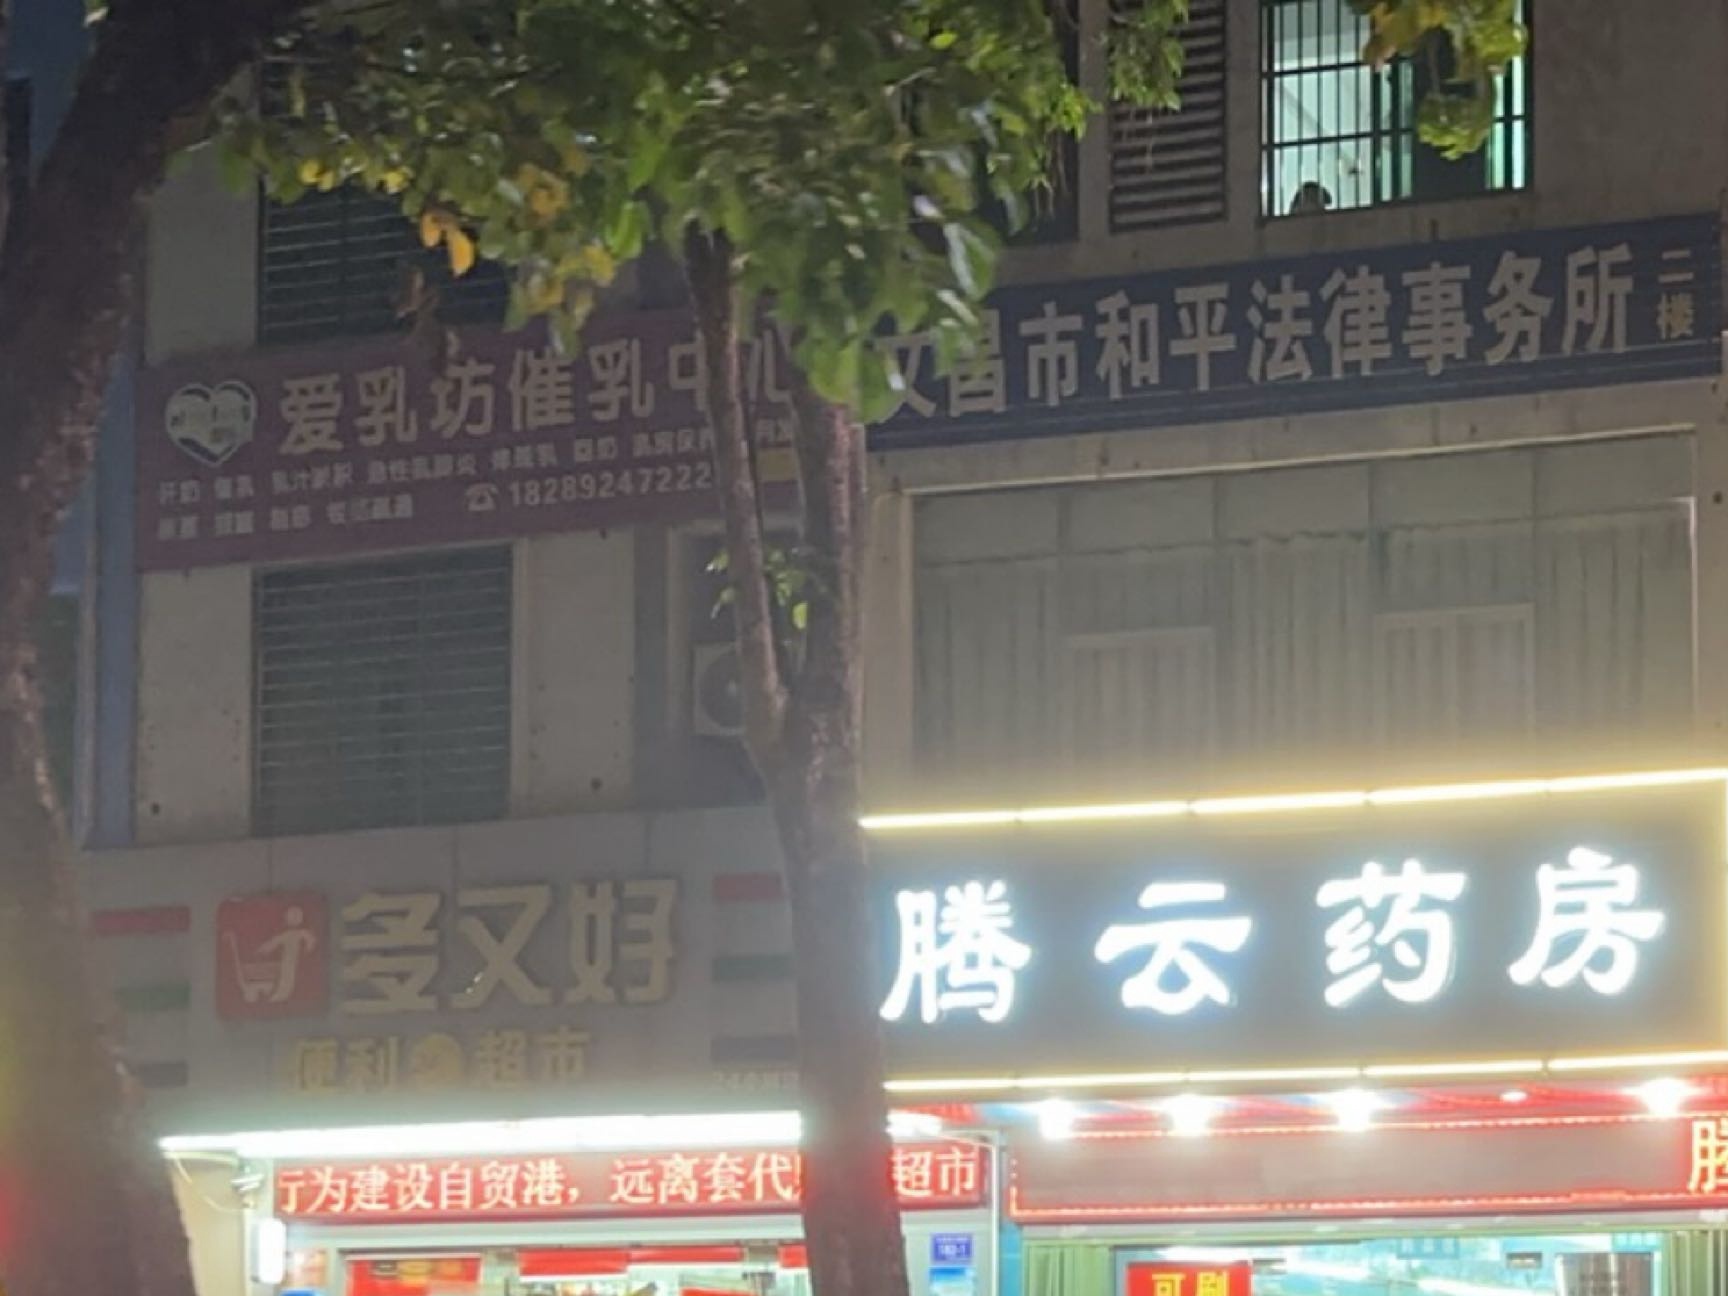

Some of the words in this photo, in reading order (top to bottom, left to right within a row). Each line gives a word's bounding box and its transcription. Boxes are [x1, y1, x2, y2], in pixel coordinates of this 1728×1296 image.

[1657, 249, 1694, 340] 二楼
[509, 461, 712, 508] 18289247222
[341, 879, 679, 1014] 多又好
[880, 846, 1666, 1024] 腾云药房
